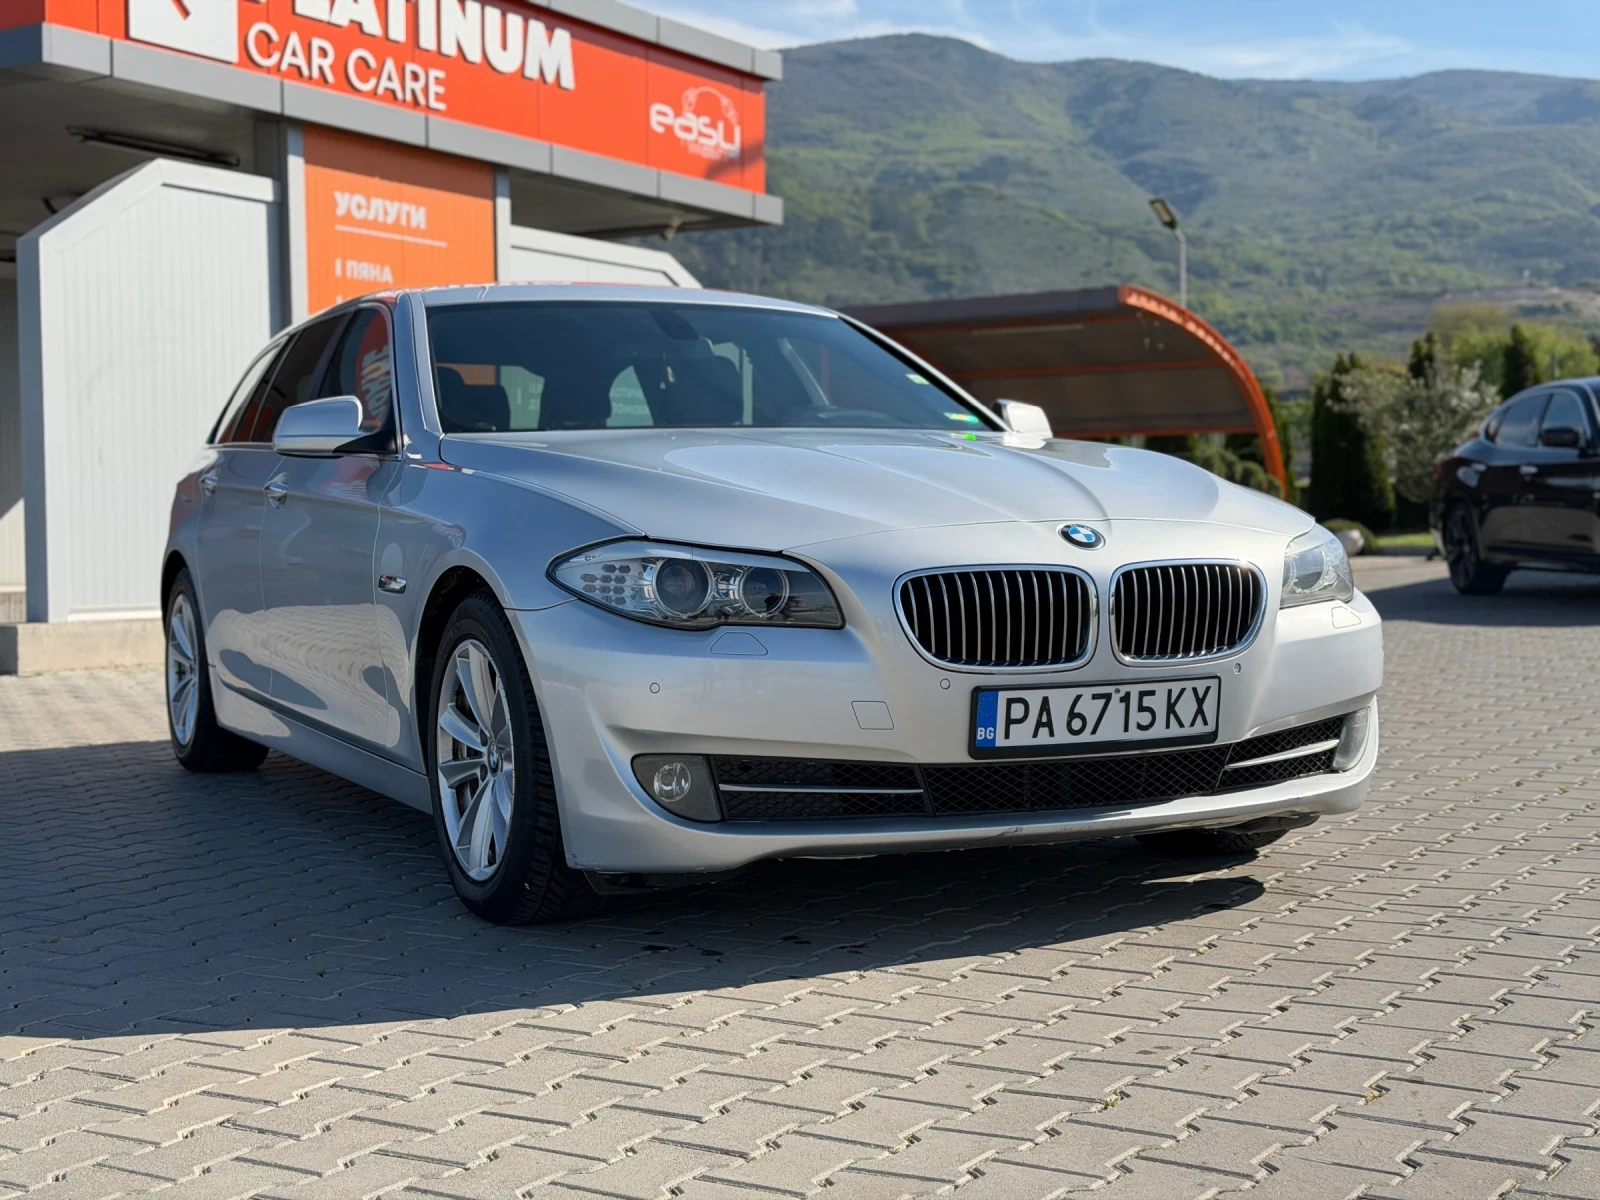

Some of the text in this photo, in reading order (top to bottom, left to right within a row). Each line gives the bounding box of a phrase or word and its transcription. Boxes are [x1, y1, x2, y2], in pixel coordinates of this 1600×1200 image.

[246, 22, 447, 111] CAR CARE
[333, 190, 427, 230] УСЛУГИ
[345, 259, 394, 284] ПЯНА
[1003, 685, 1212, 740] PA 6715 KX
[976, 727, 995, 741] BG
